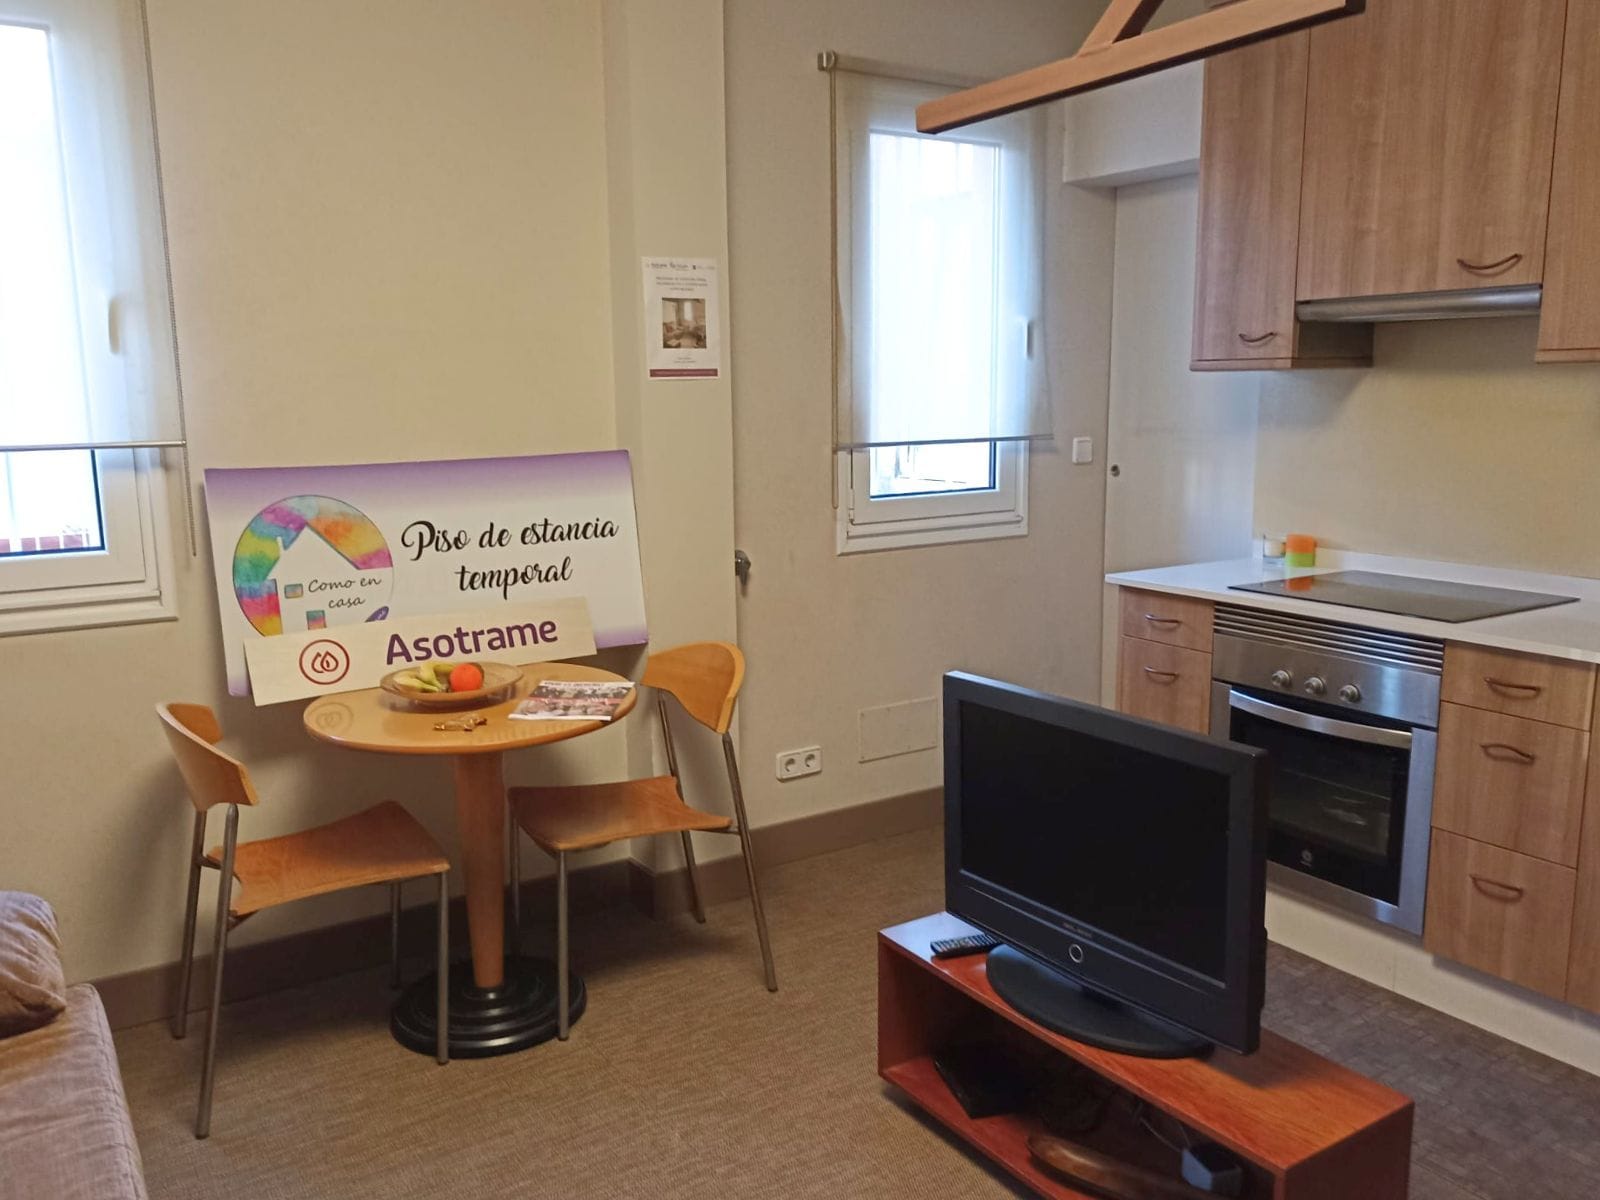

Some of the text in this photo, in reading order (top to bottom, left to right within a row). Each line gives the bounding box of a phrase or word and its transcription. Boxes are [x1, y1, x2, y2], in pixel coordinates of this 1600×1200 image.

[401, 517, 619, 561] Piso de estancia
[308, 575, 382, 593] Como en
[455, 556, 572, 600] temporal
[328, 597, 366, 609] casa
[386, 619, 558, 666] Asotrame
